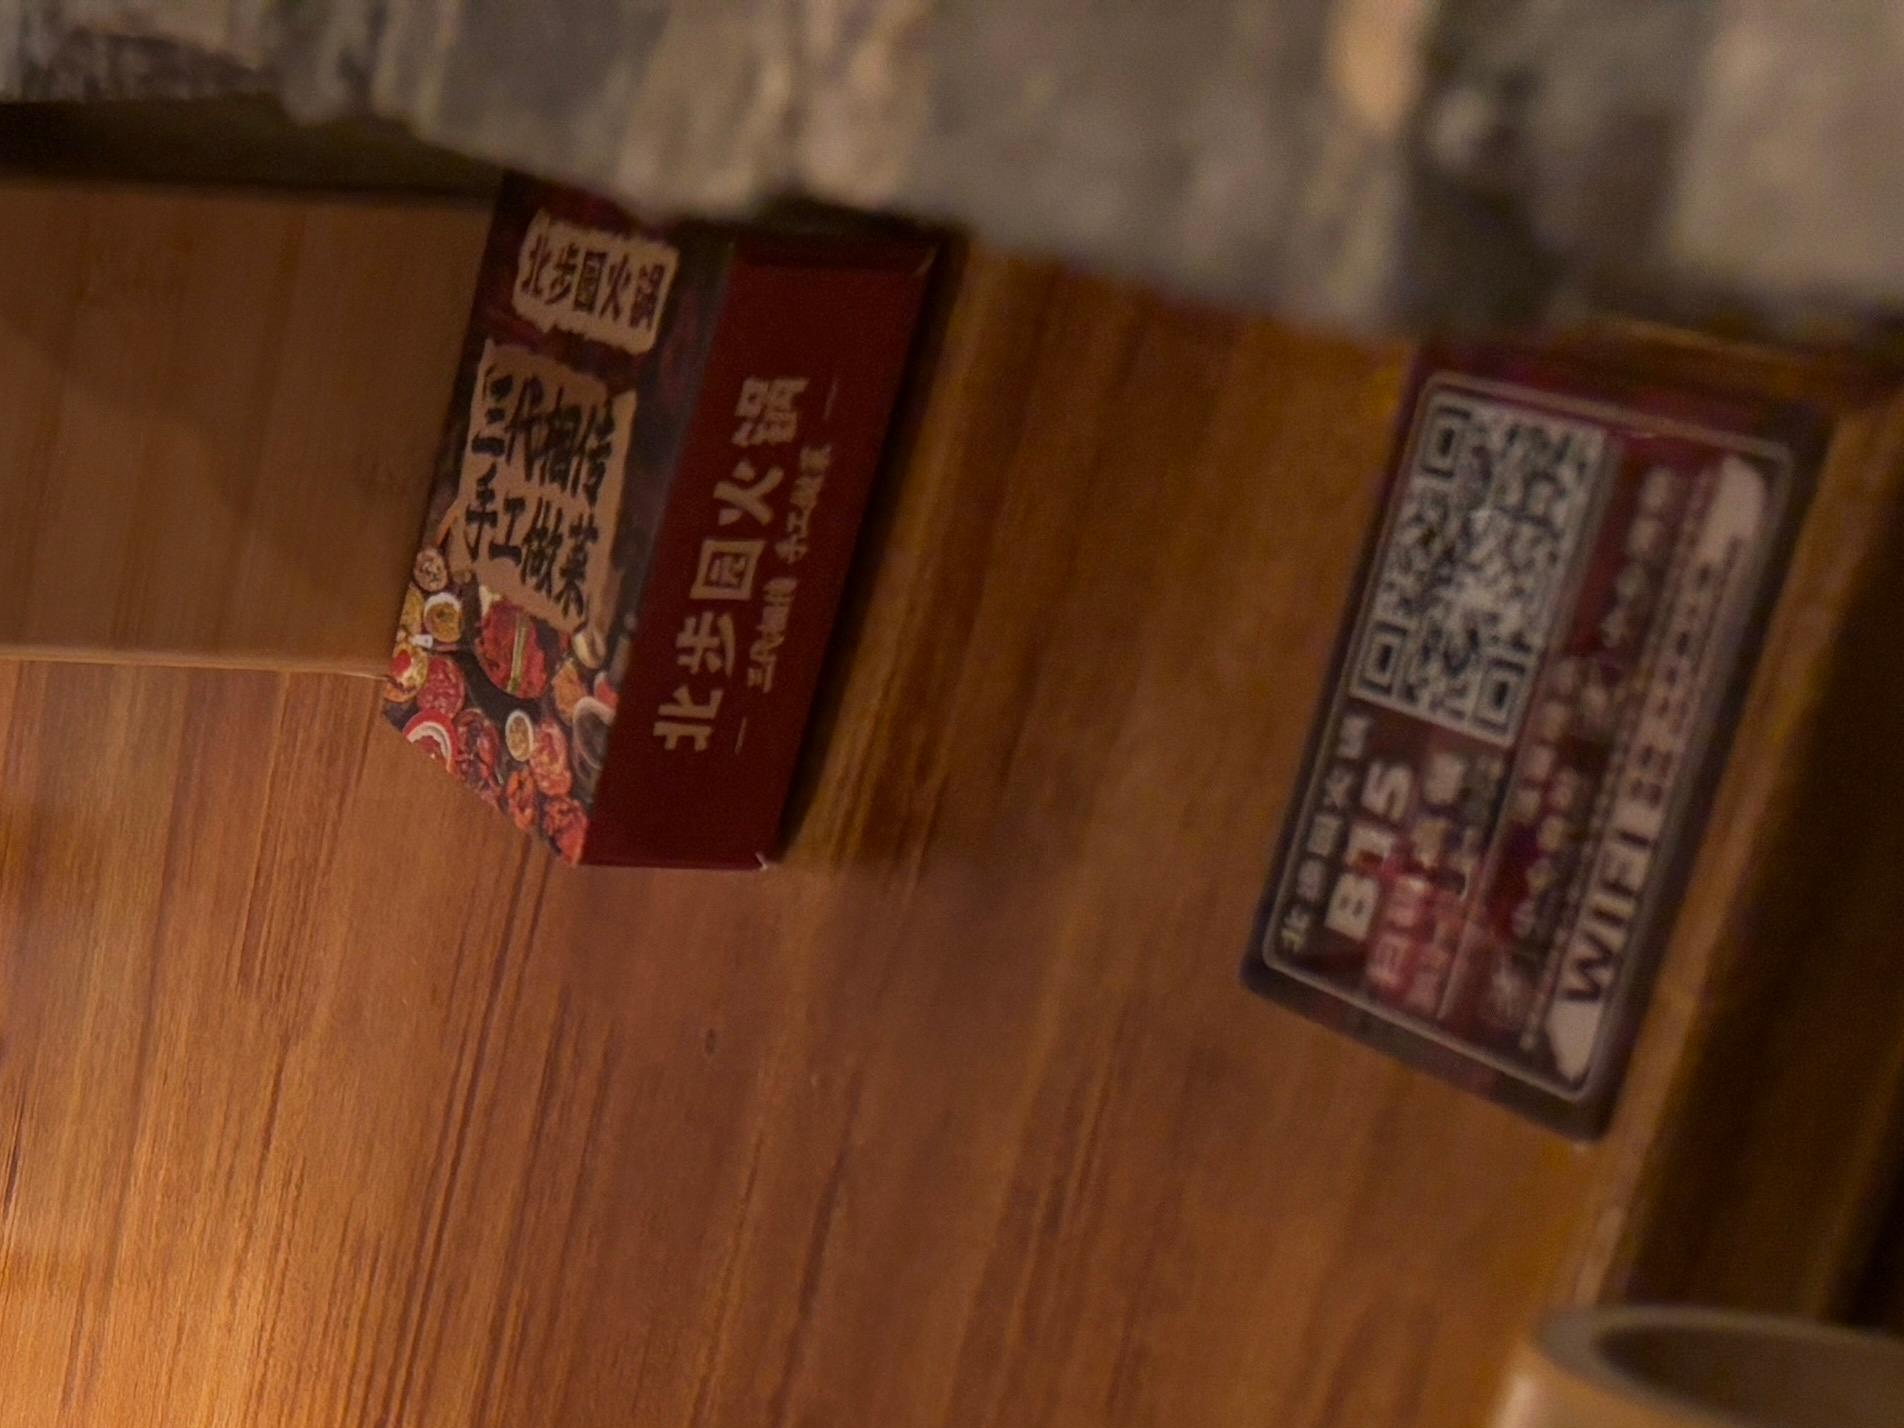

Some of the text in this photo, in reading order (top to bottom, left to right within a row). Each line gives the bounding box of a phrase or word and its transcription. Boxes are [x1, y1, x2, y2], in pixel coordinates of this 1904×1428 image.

[652, 376, 810, 753] 北步园火锅
